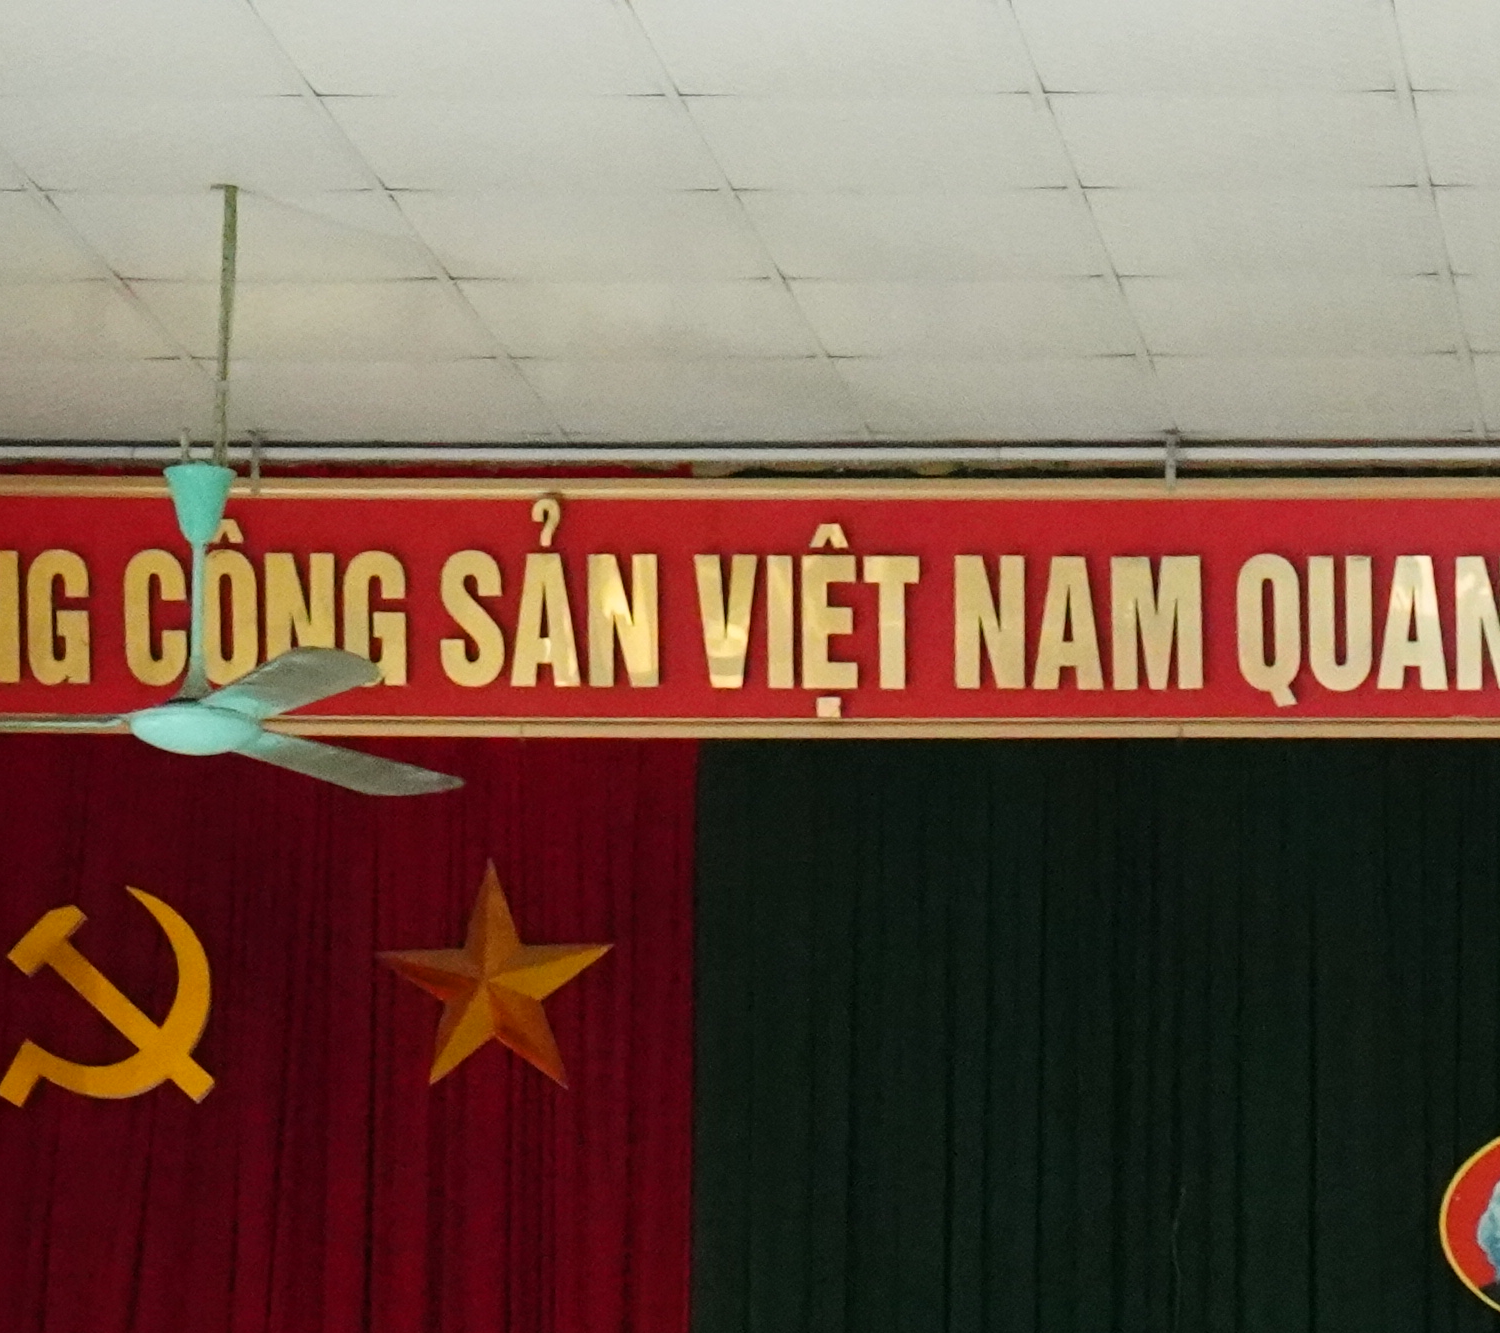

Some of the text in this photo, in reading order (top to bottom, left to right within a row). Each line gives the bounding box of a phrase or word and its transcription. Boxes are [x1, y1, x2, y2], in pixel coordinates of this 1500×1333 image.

[439, 498, 660, 688] SẢN
[693, 523, 920, 718] VIỆT
[953, 555, 1204, 690] NAM
